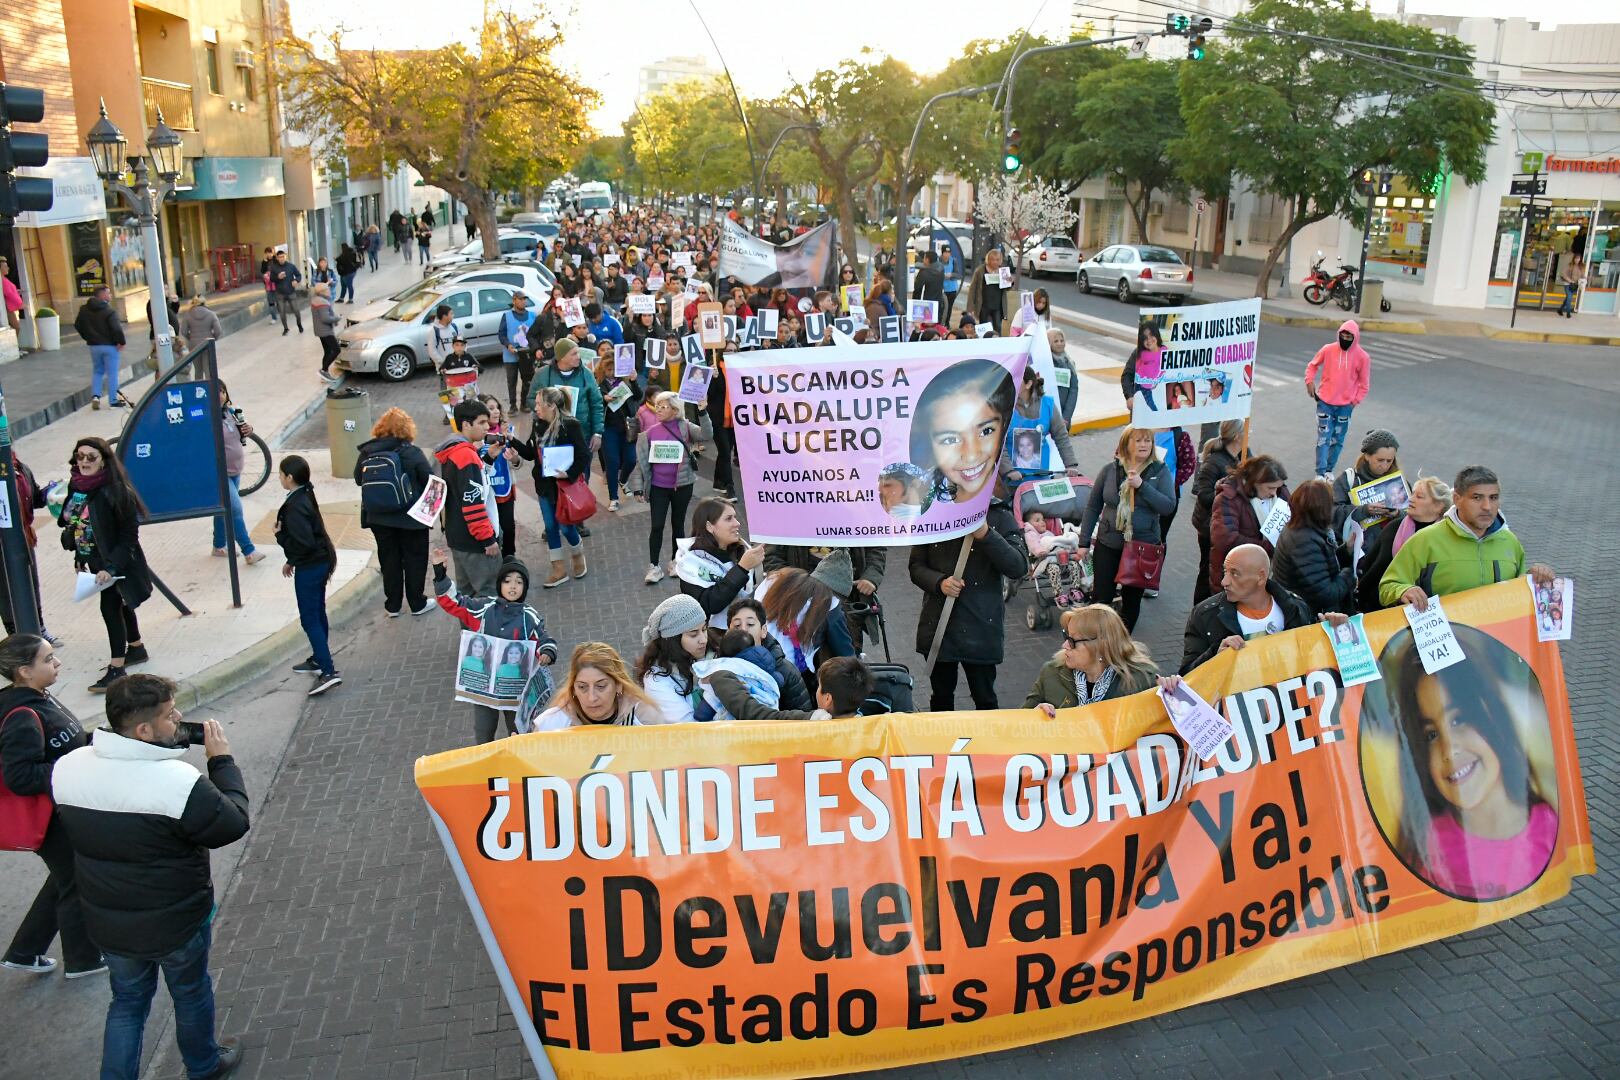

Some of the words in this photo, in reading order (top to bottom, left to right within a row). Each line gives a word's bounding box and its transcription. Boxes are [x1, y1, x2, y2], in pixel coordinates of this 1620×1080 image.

[647, 339, 666, 367] U
[688, 336, 704, 363] A
[758, 310, 777, 337] L
[805, 314, 825, 341] U
[881, 318, 899, 343] E
[1171, 323, 1179, 341] A
[1181, 322, 1203, 341] SAN
[1205, 319, 1224, 340] LUIS
[1226, 317, 1235, 336] LE
[1236, 314, 1256, 335] SIGUE
[1161, 347, 1213, 370] FALTANDO
[740, 368, 885, 395] BUSCAMOS
[892, 367, 910, 388] A
[734, 396, 910, 426] GUADALUPE
[766, 427, 882, 455] LUCERO
[762, 468, 845, 483] AYUDANOS
[849, 468, 860, 480] A
[758, 489, 874, 504] ENCONTRARLA!!
[816, 526, 852, 536] LUNAR
[855, 525, 890, 536] SOBRE
[893, 525, 907, 535] LA
[910, 521, 951, 534] PATILLA
[1264, 508, 1282, 534] DONDE
[1424, 617, 1445, 630] VIDA
[1428, 643, 1450, 661] YA!
[477, 754, 781, 862] ¿DÓNDE
[804, 738, 987, 846] ESTÁ
[564, 833, 1181, 971] ¡Devuelvanla
[1188, 770, 1311, 885] Ya!
[529, 980, 591, 1052] El
[617, 973, 877, 1052] Estado
[906, 964, 988, 1031] Es
[1013, 855, 1390, 1015] Responsable
